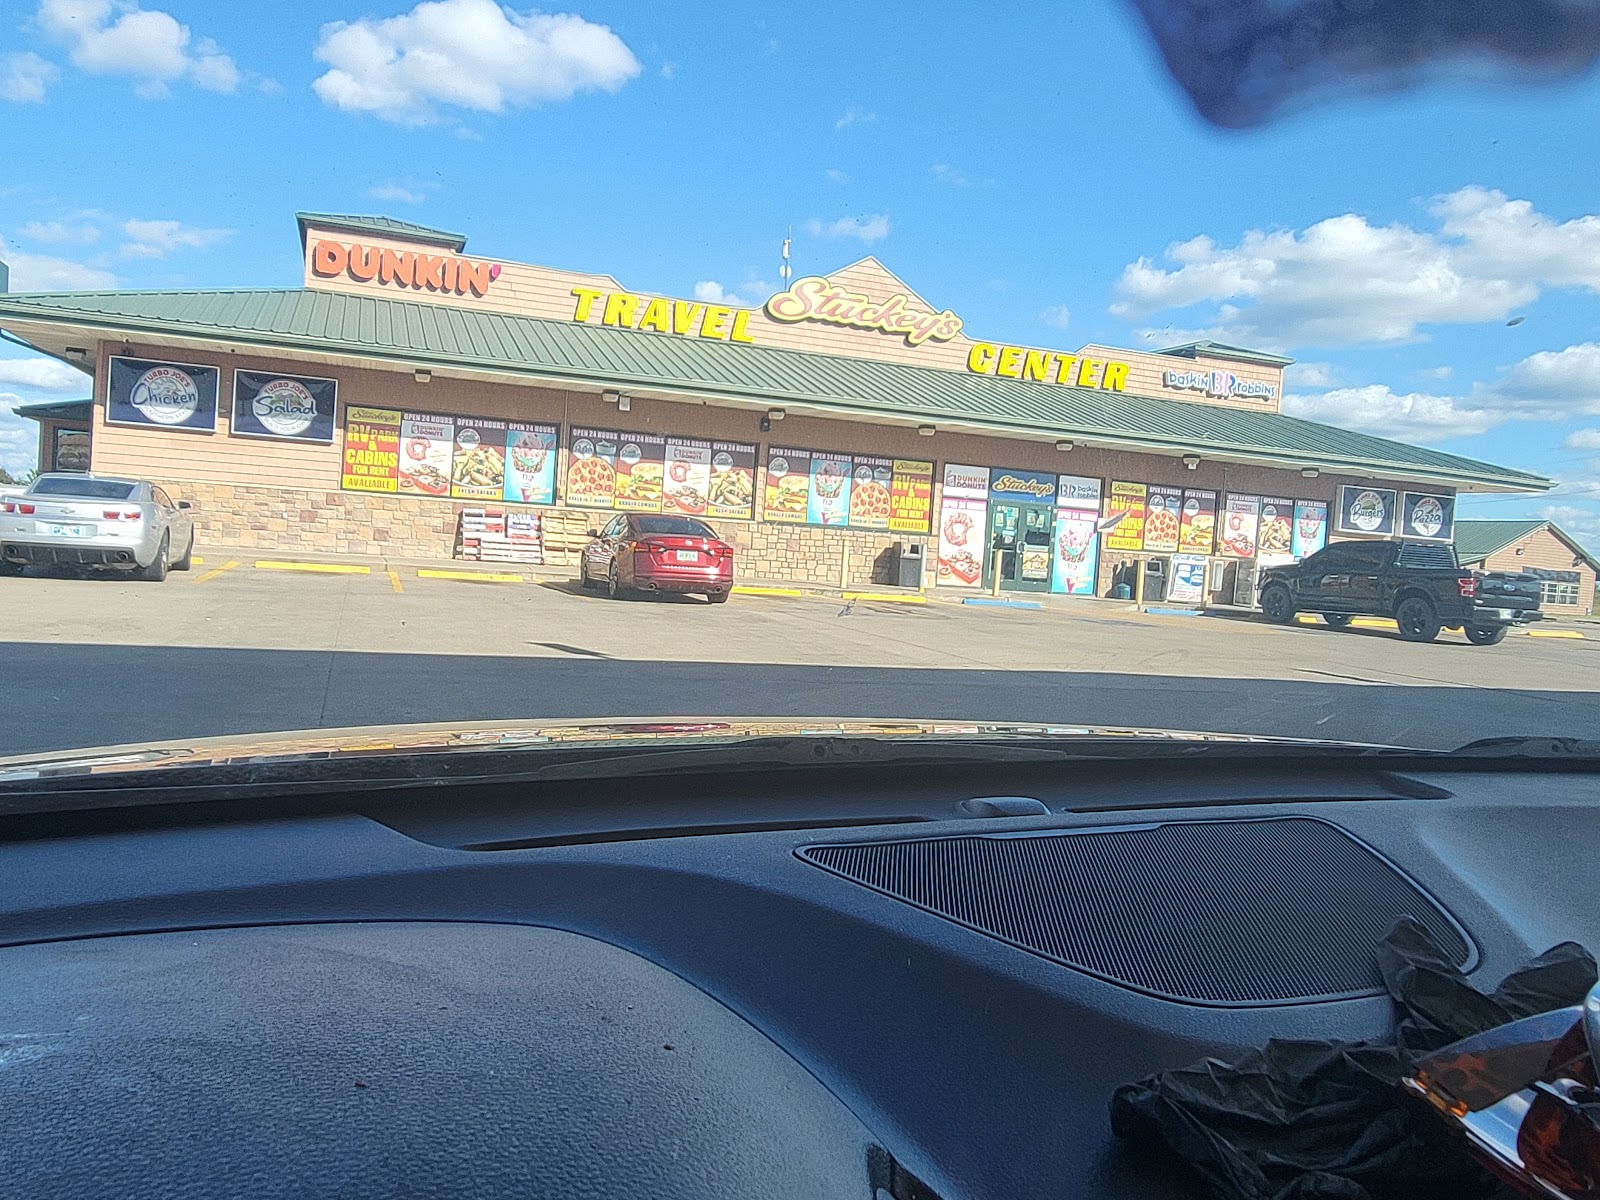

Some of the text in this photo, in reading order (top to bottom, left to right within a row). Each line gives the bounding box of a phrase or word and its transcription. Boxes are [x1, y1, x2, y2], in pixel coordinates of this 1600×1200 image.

[314, 240, 501, 295] DUNKIN'
[571, 287, 755, 343] TRAVEL
[770, 279, 961, 341] Stuckey's
[969, 343, 1130, 392] CENTER
[144, 368, 191, 388] TURBO JOE'S
[1168, 370, 1209, 388] baskin
[1236, 380, 1276, 398] robbins
[131, 382, 196, 406] Chicken
[264, 382, 309, 400] TURBO JOE'S
[254, 396, 316, 416] Salad
[404, 413, 453, 424] OPEN 24 HOURS
[457, 418, 505, 430] OPEN 24 HOURS
[348, 424, 371, 442] RV
[509, 423, 556, 434] OPEN 24 HOURS
[573, 428, 618, 440] OPEN 24 HOURS
[620, 432, 664, 444] OPEN 24 HOURS
[668, 437, 682, 446] OPEN
[691, 440, 711, 449] HOURS
[713, 442, 728, 450] OPEN
[735, 443, 755, 453] HOURS
[770, 447, 783, 456] OPEN
[791, 450, 810, 459] HOURS
[346, 449, 397, 468] CABINS
[812, 452, 852, 462] OPEN 24 HOURS
[854, 456, 867, 464] OPEN
[875, 458, 893, 466] HOURS
[893, 474, 911, 491] RV
[956, 475, 987, 483] DUNKIN'
[956, 482, 986, 490] DONUTS
[993, 475, 1055, 497] Stuckey's
[892, 495, 929, 510] CABINS
[1351, 503, 1384, 522] Burgers
[1413, 509, 1441, 523] Pizza
